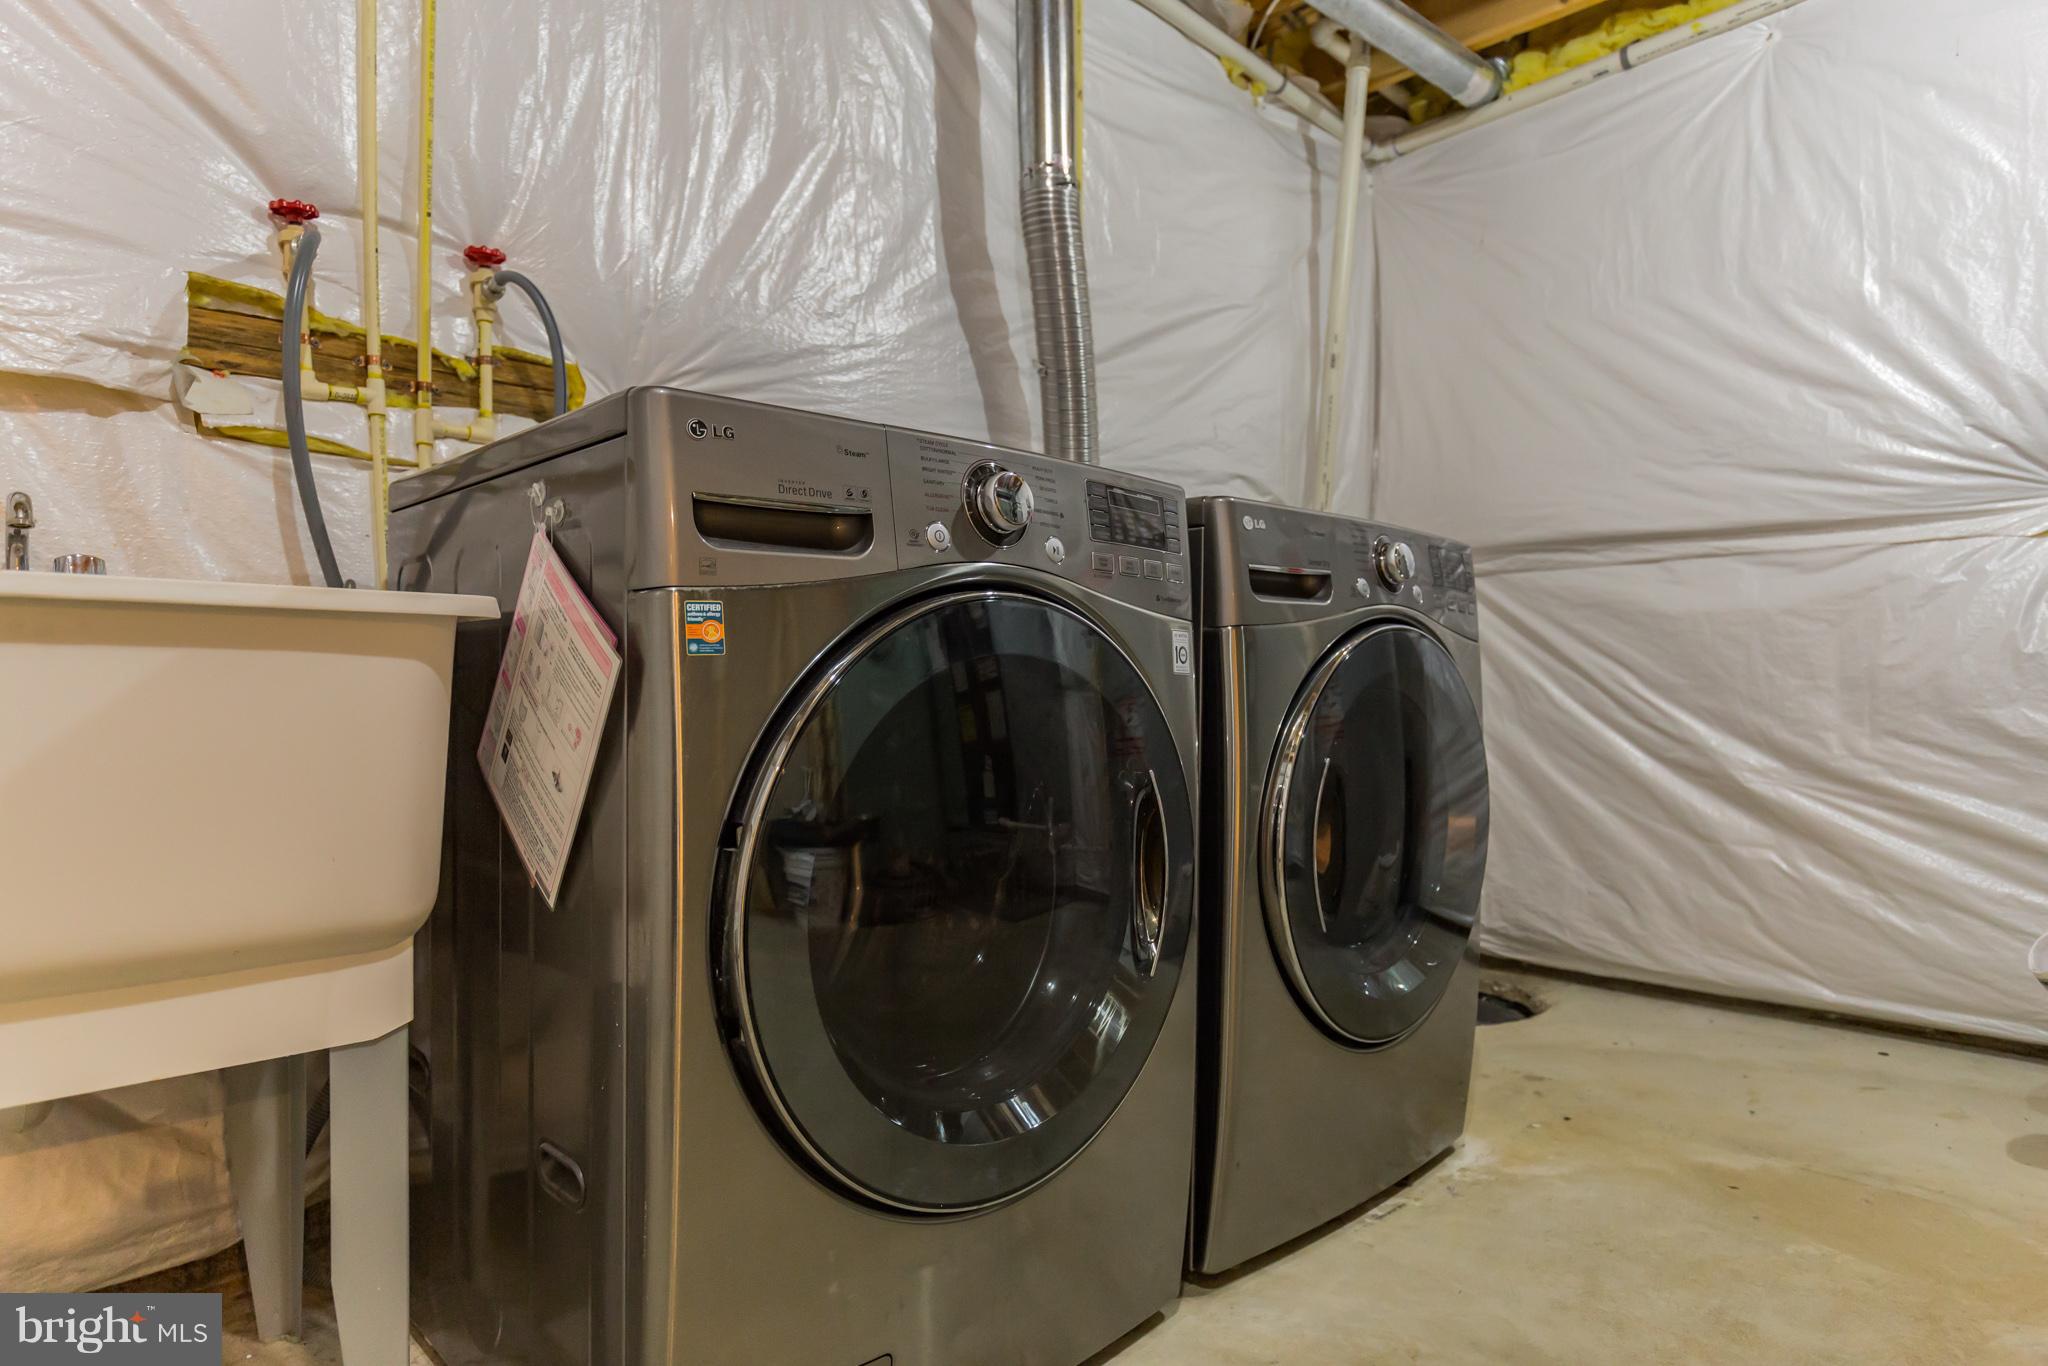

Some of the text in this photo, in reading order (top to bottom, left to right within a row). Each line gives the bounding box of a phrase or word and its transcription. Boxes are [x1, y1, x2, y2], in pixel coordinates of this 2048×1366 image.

[711, 423, 735, 439] LG
[778, 484, 833, 500] Direct Drive
[1254, 520, 1266, 529] LG
[1175, 645, 1188, 665] 10
